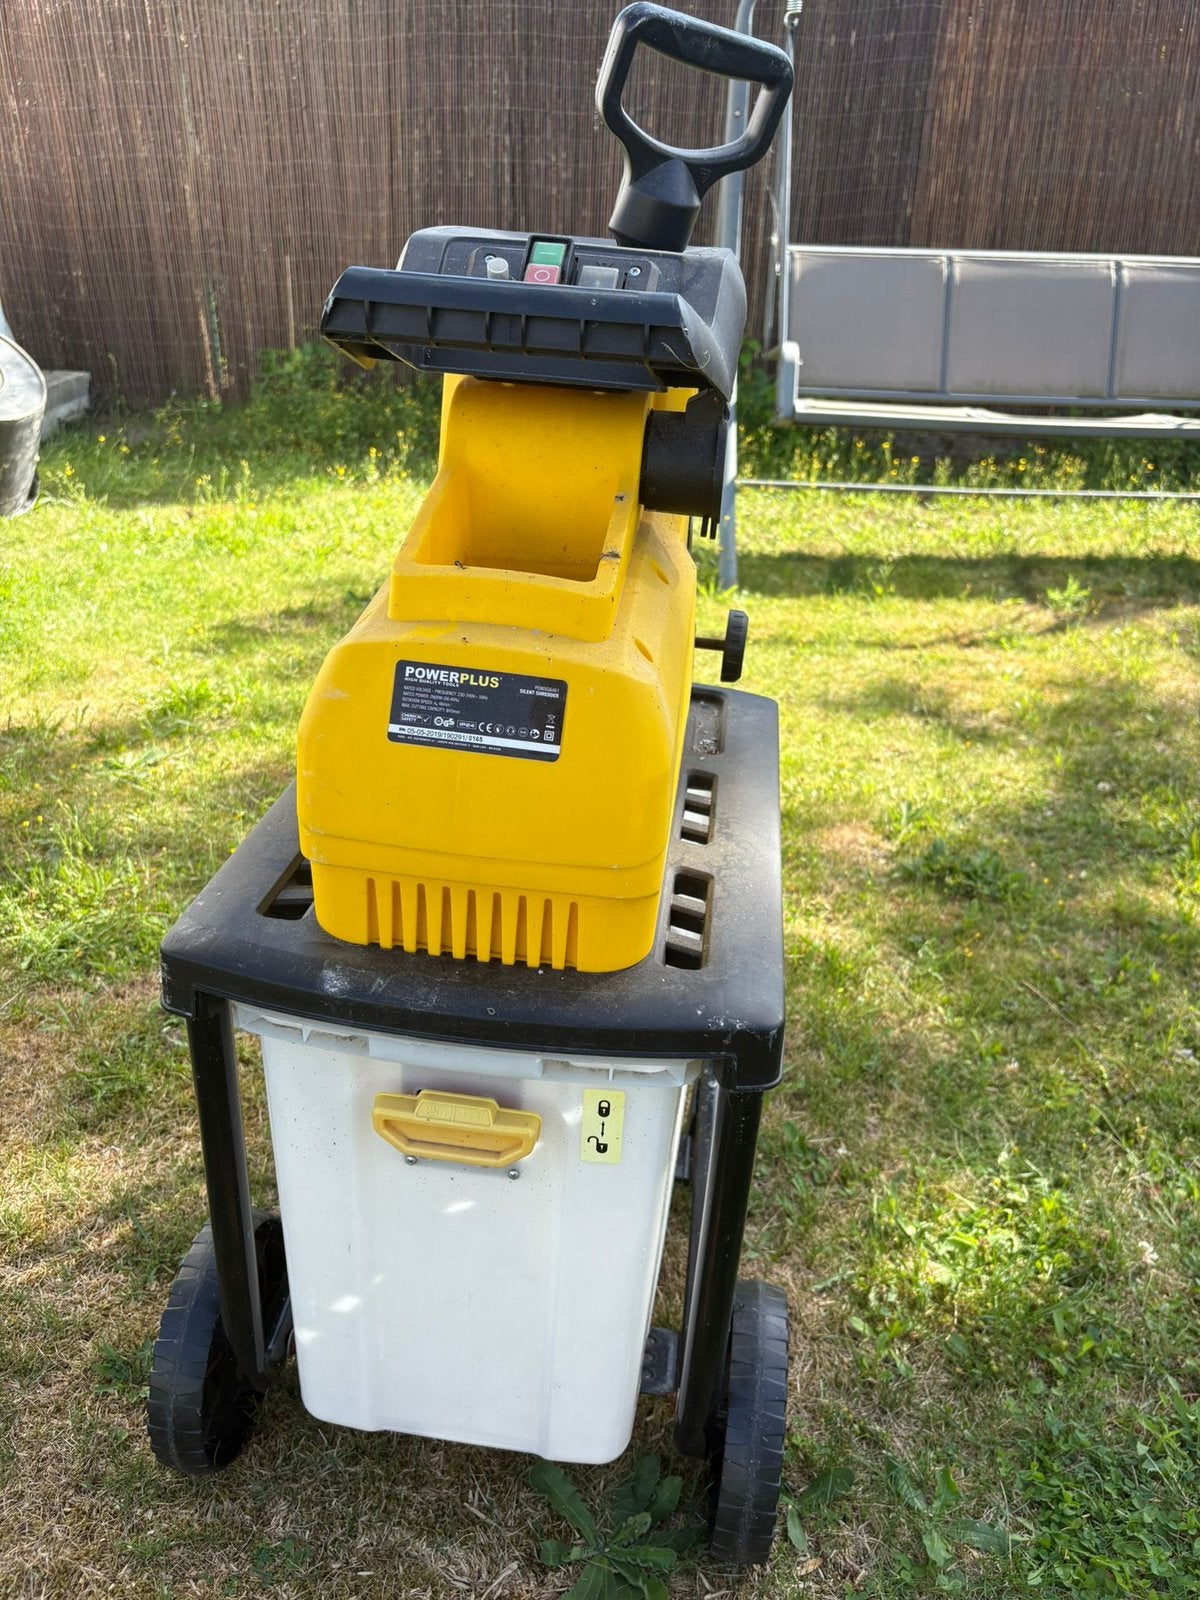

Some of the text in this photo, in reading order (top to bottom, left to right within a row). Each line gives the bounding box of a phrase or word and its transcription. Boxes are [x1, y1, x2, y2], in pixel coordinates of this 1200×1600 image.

[405, 666, 500, 688] POWERPLUS
[444, 718, 454, 727] GS
[478, 722, 492, 733] CE
